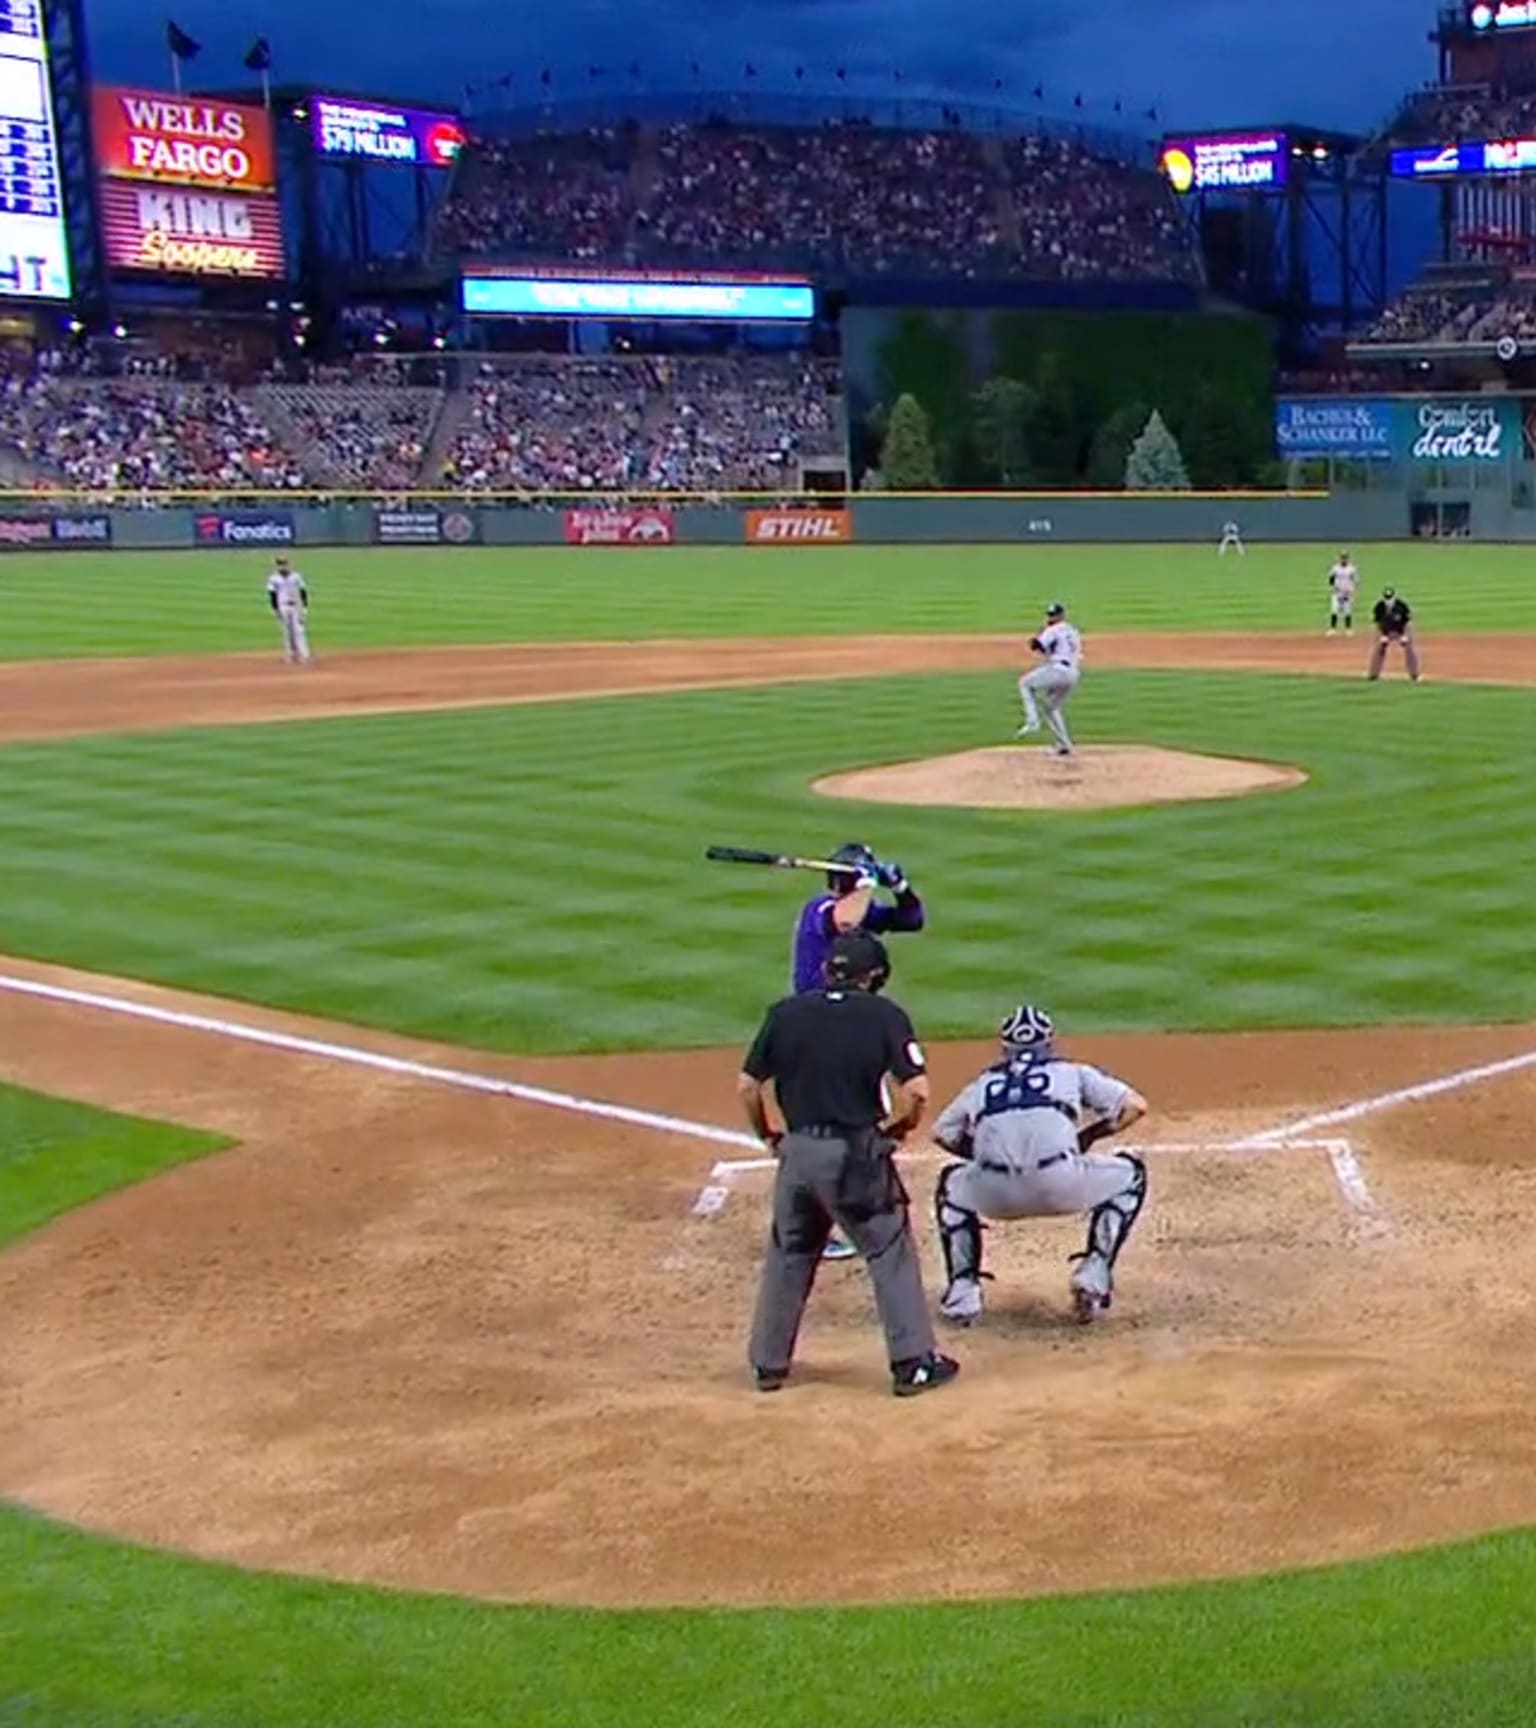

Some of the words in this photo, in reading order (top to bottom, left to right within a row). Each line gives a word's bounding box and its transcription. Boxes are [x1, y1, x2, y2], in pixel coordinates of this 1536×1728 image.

[121, 98, 244, 141] WELLS
[129, 136, 249, 178] FARGO
[137, 189, 252, 238] KING
[139, 230, 259, 270] Soopers
[1419, 403, 1496, 428] Comfort
[1413, 425, 1501, 457] dental
[223, 518, 291, 541] Fanatics
[756, 516, 841, 538] STIHL
